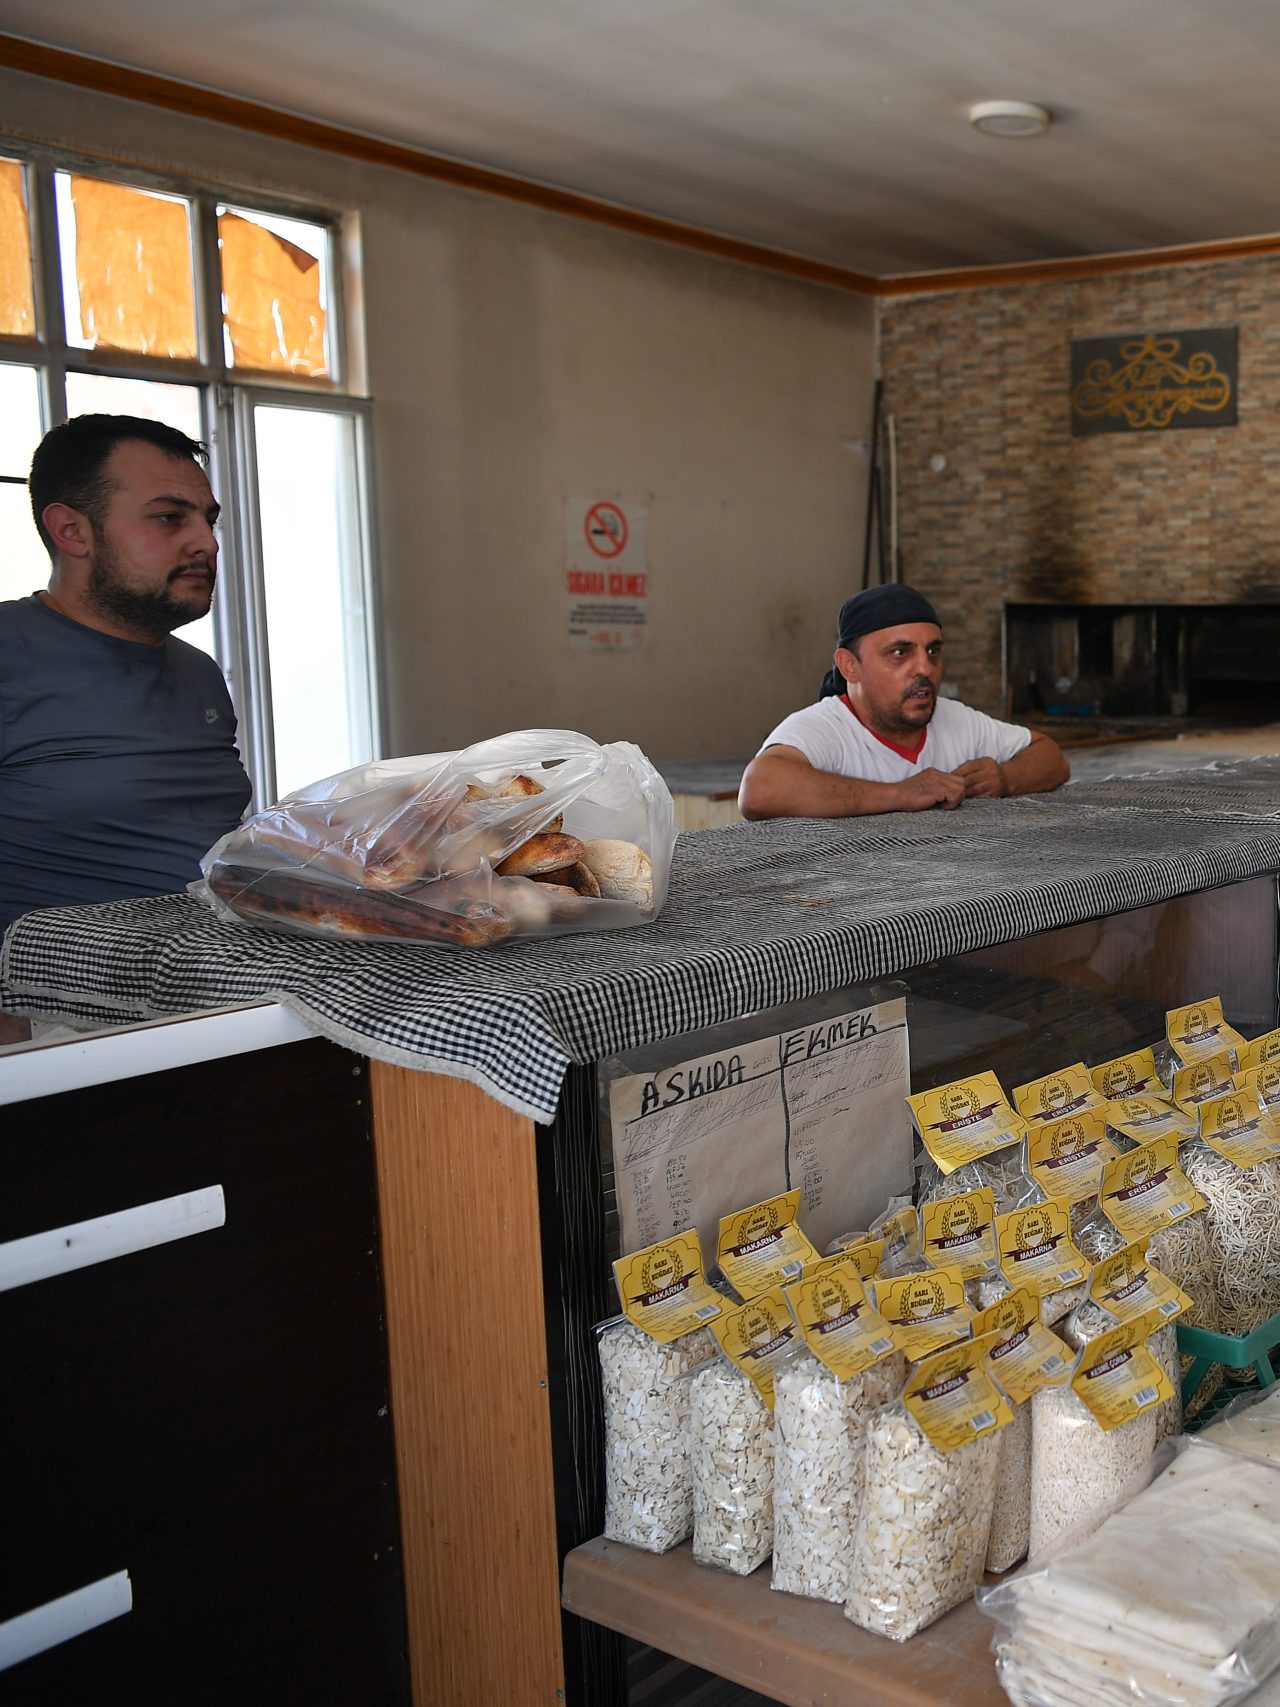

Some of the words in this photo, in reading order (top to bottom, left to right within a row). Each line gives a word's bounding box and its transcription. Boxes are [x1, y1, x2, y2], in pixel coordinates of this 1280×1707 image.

[641, 1054, 745, 1116] ASKIDA
[783, 1012, 879, 1064] EKMEK
[950, 1094, 964, 1103] SARI
[950, 1100, 970, 1112] BUĞDAY
[1052, 1104, 1077, 1118] ERİŞTE
[952, 1114, 982, 1129] ERİŞTE
[1058, 1150, 1088, 1165] ERİŞTE
[1128, 1180, 1158, 1197] ERİŞTE
[954, 1210, 966, 1218] SARI
[950, 1217, 970, 1228] BUĞDAY
[1028, 1220, 1039, 1228] SARI
[1024, 1227, 1044, 1238] BUĞDAY
[740, 1234, 778, 1255] MAKARNA
[944, 1232, 978, 1248] MAKARNA
[1020, 1243, 1052, 1260] MAKARNA
[654, 1259, 668, 1269] SARI
[652, 1266, 674, 1280] BUĞDAY
[648, 1283, 684, 1304] MAKARNA
[914, 1289, 928, 1298] SARI
[1116, 1279, 1144, 1298] MAKARNA
[910, 1298, 934, 1308] BUĞDAY
[824, 1312, 856, 1332] MAKARNA
[926, 1376, 965, 1398] MAKARNA
